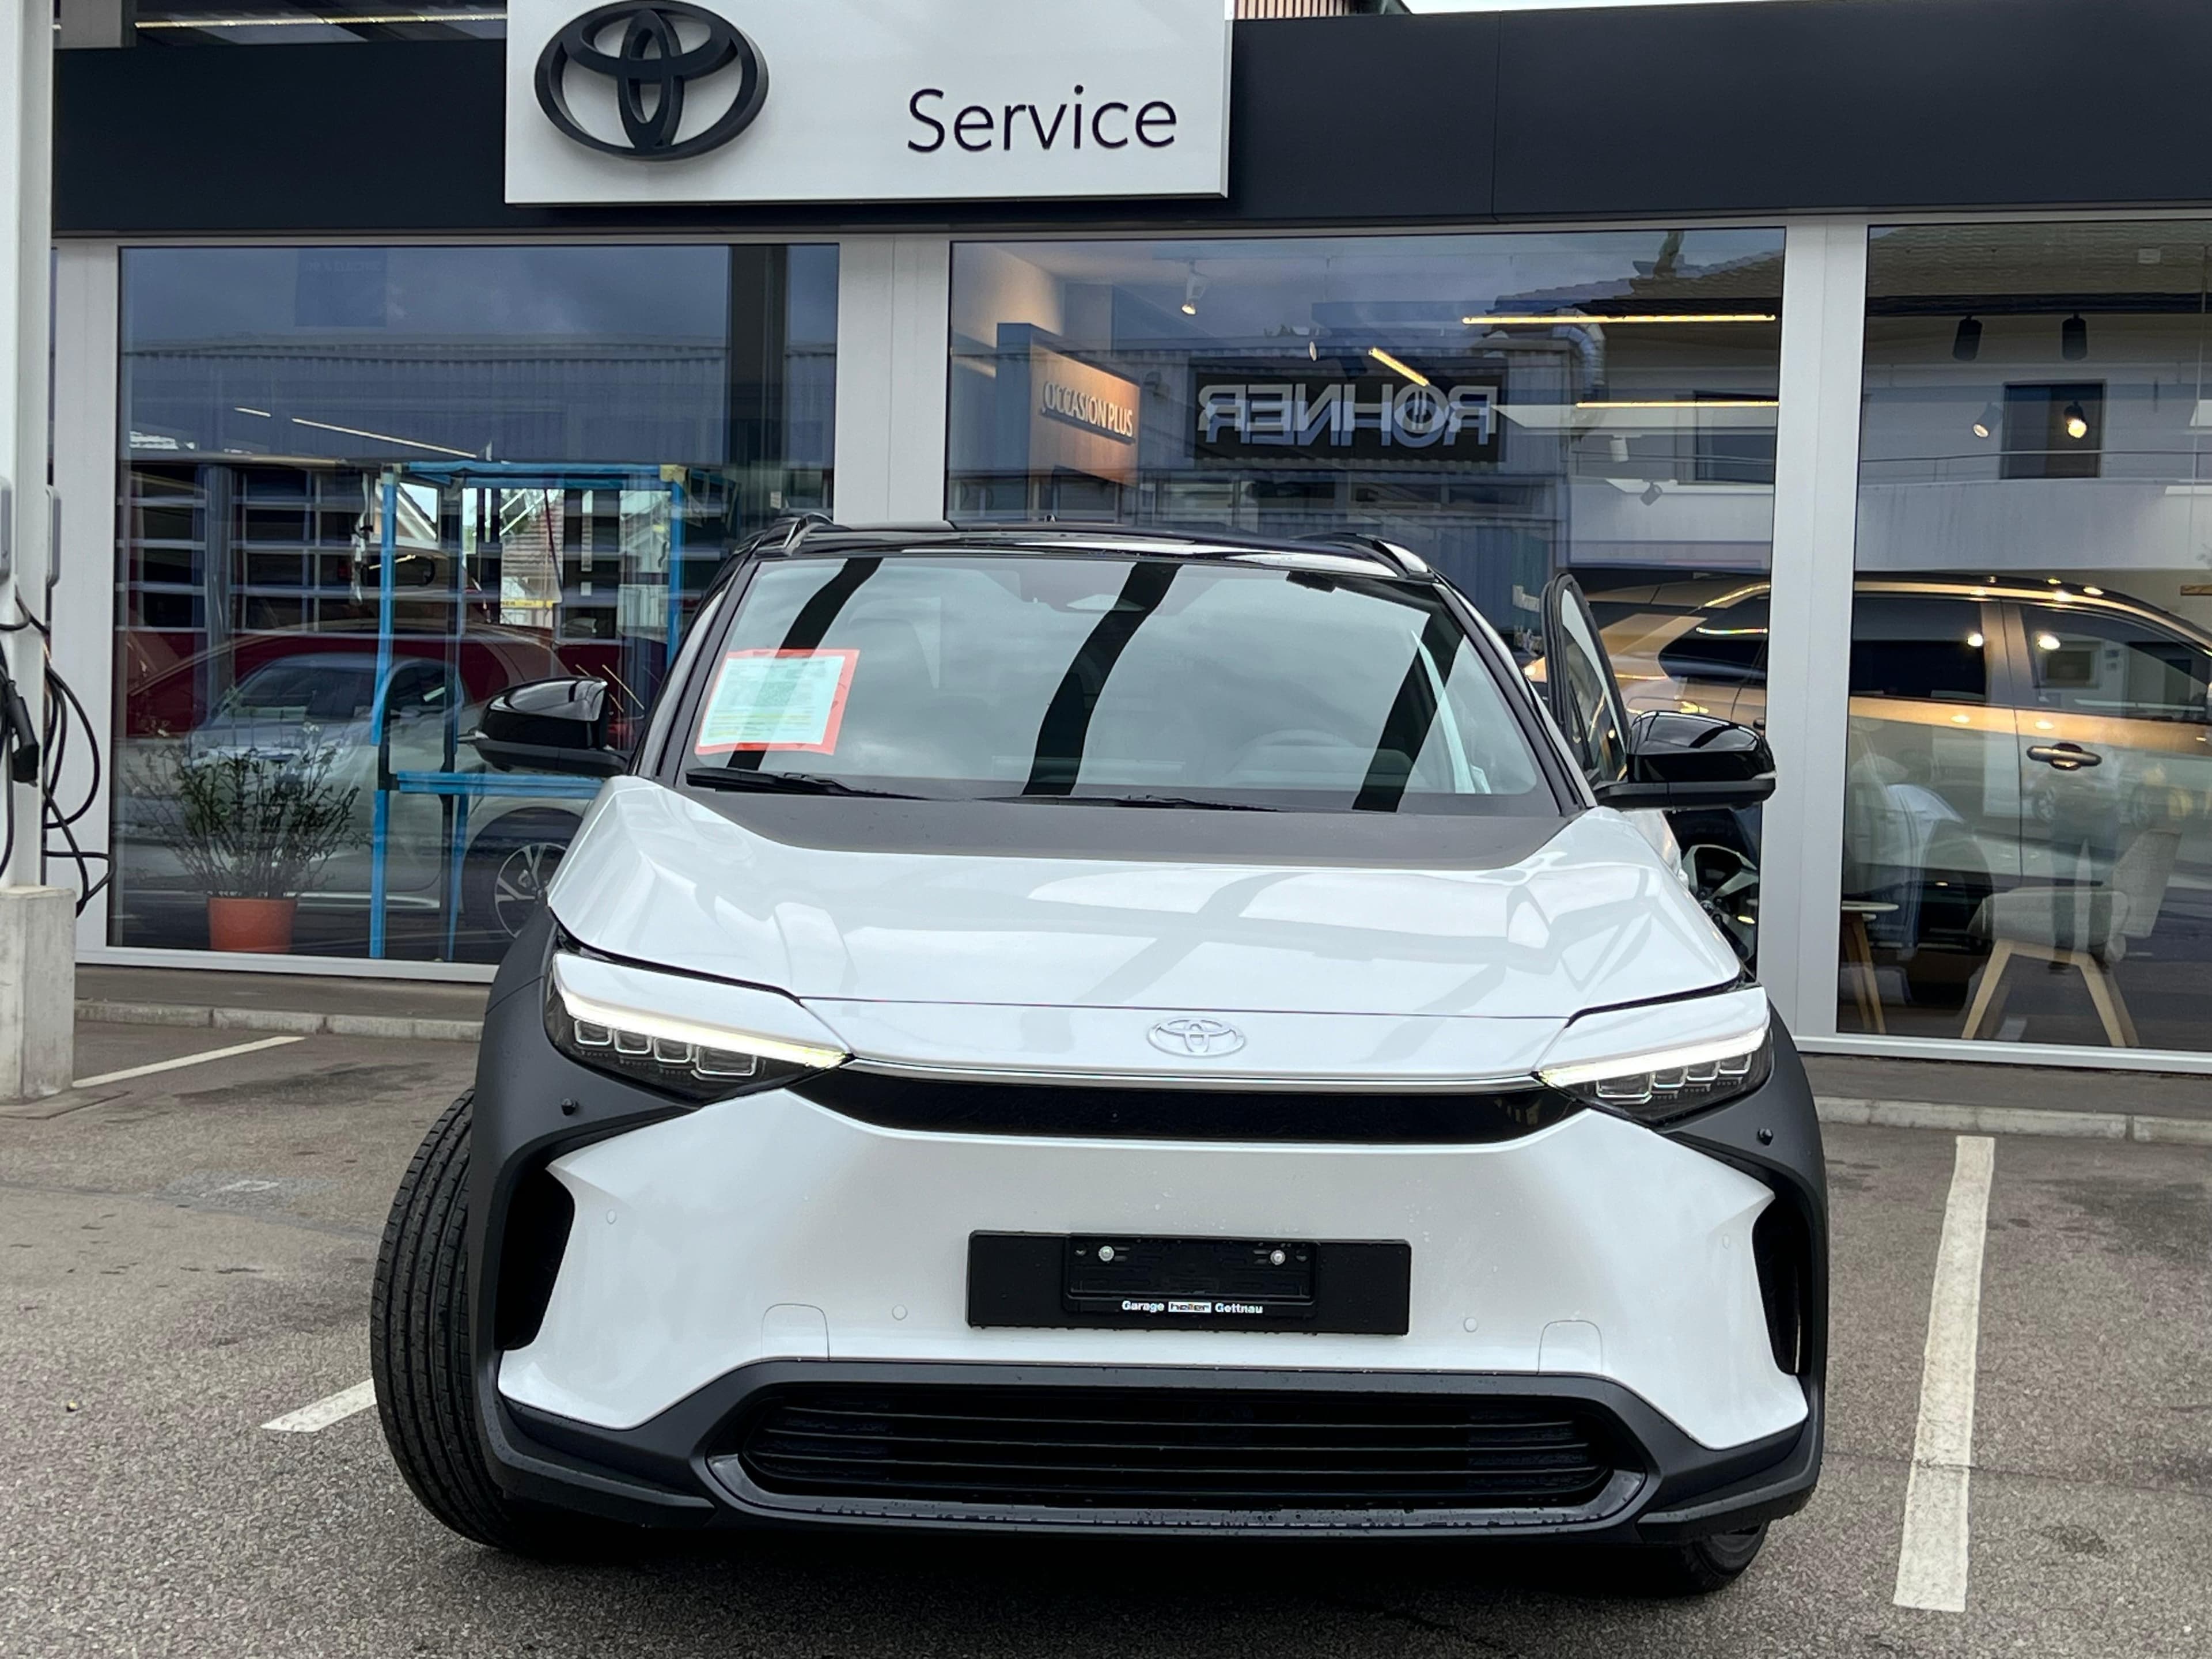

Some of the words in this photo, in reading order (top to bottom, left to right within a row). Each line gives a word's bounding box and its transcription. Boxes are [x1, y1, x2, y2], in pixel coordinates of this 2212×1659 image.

[907, 84, 1177, 153] Service
[1044, 381, 1107, 429] OCCASION
[1107, 403, 1133, 437] PLUS
[1122, 1300, 1165, 1313] Garage
[1214, 1302, 1263, 1314] Gettnau
